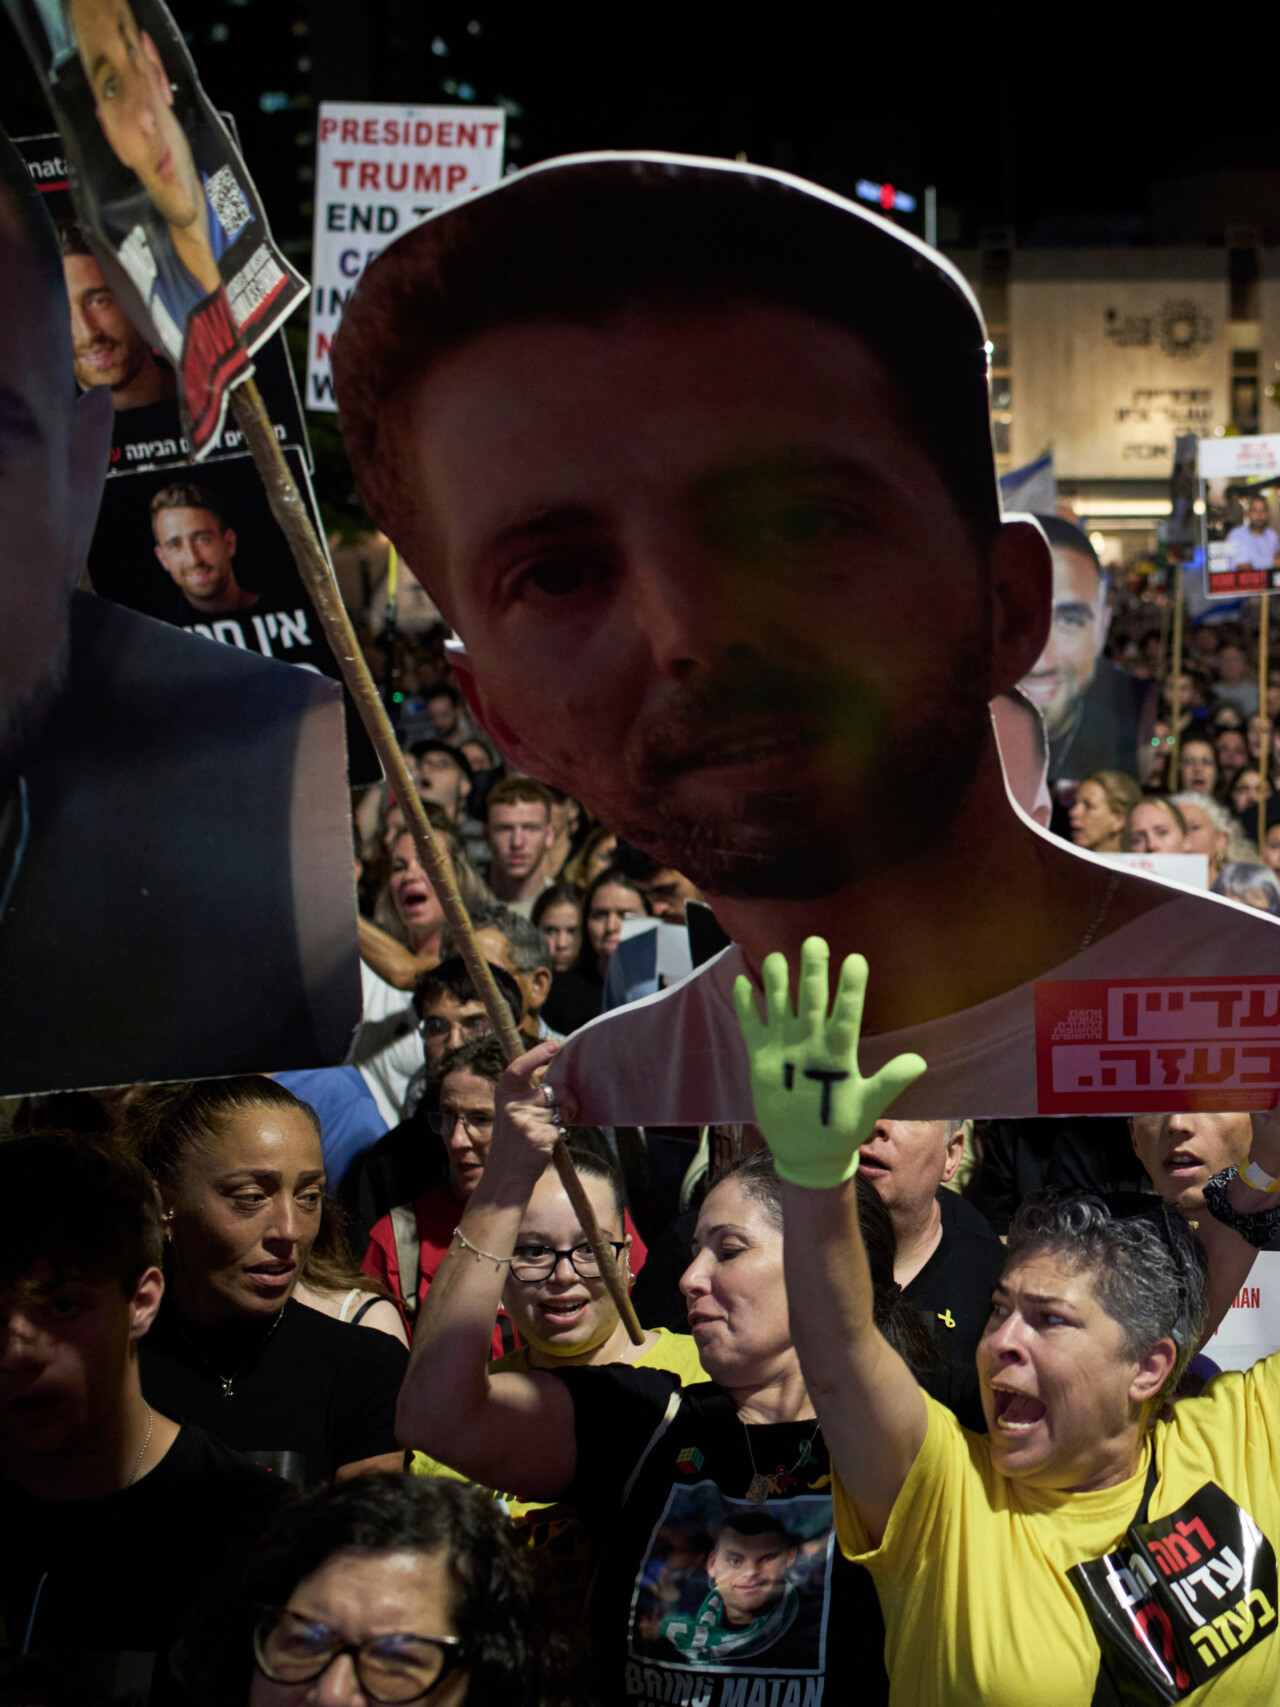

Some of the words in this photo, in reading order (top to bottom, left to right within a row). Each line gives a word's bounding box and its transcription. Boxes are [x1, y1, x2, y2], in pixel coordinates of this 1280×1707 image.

[318, 117, 499, 148] PRESIDENT
[333, 160, 480, 192] TRUMP,
[326, 203, 398, 233] END
[125, 439, 177, 461] הביתה
[252, 608, 312, 657] אין
[1147, 1515, 1216, 1576] למה
[1189, 1588, 1276, 1668] בעזה
[625, 1660, 714, 1707] BRING
[719, 1675, 825, 1707] MATAN
